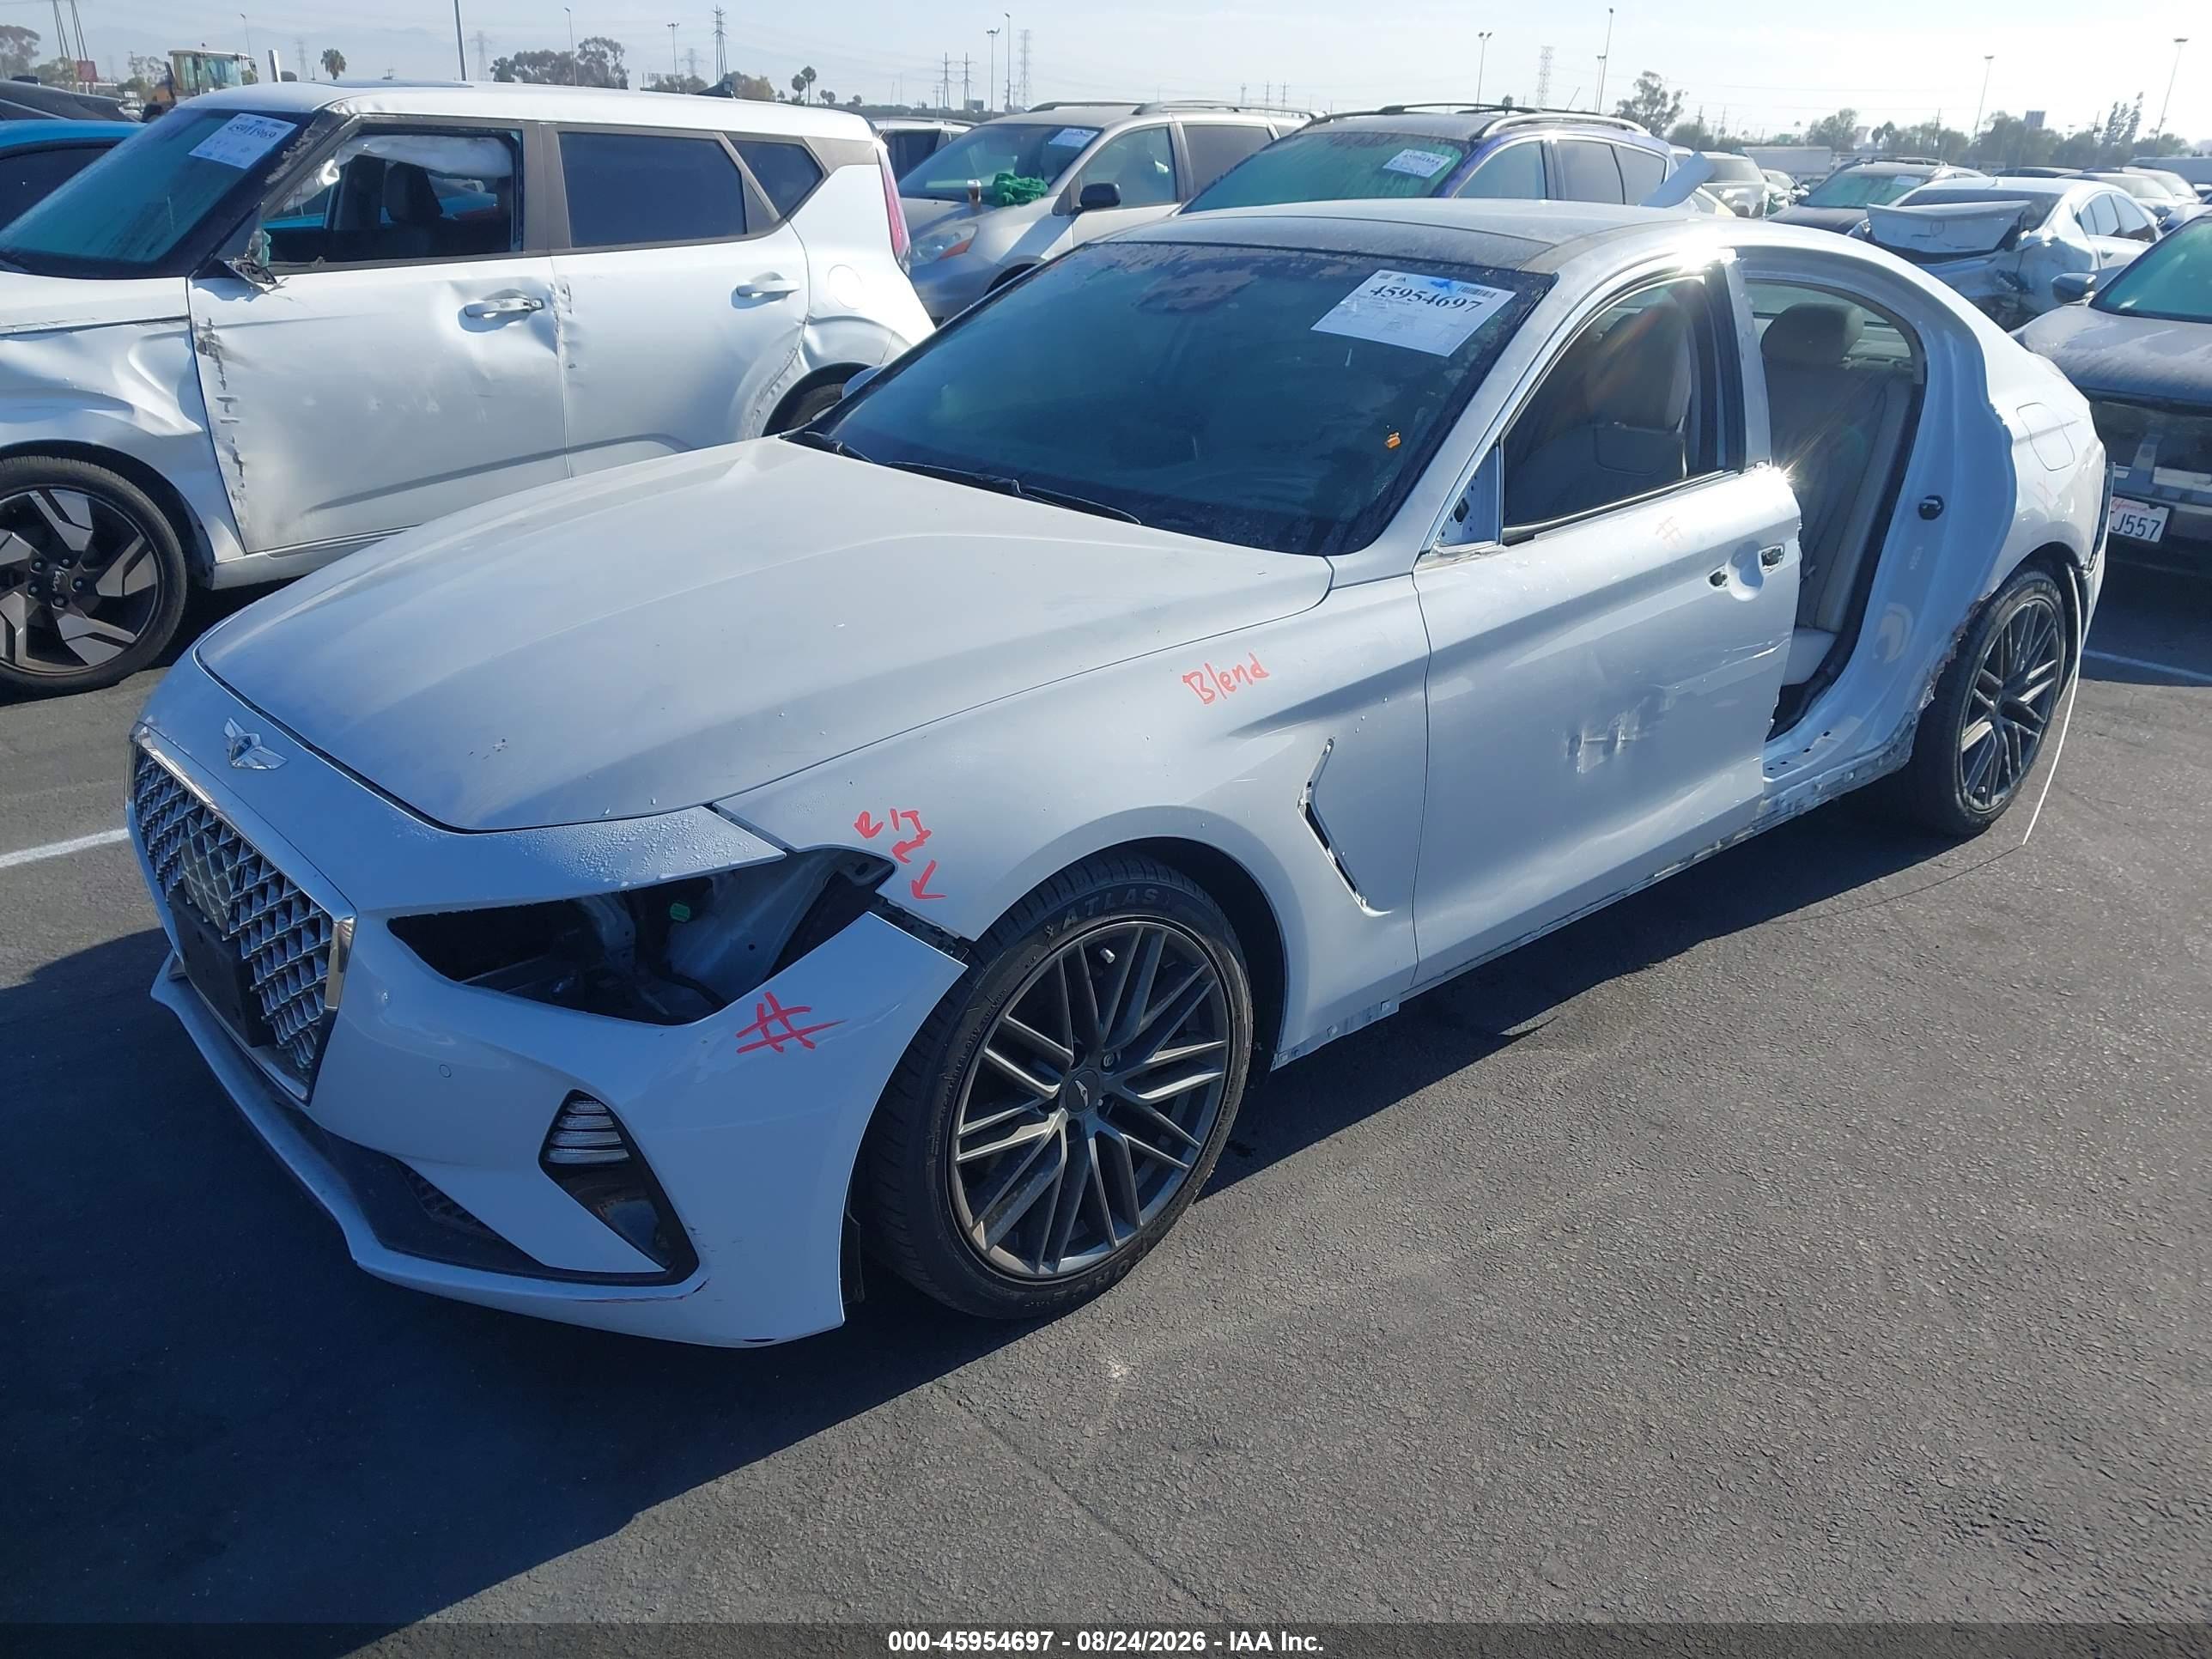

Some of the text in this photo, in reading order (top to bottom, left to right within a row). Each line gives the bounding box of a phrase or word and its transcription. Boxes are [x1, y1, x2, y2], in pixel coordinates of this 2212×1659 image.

[1370, 284, 1483, 313] 45954697
[1182, 652, 1270, 705] Blend
[1062, 888, 1159, 931] ATLAS
